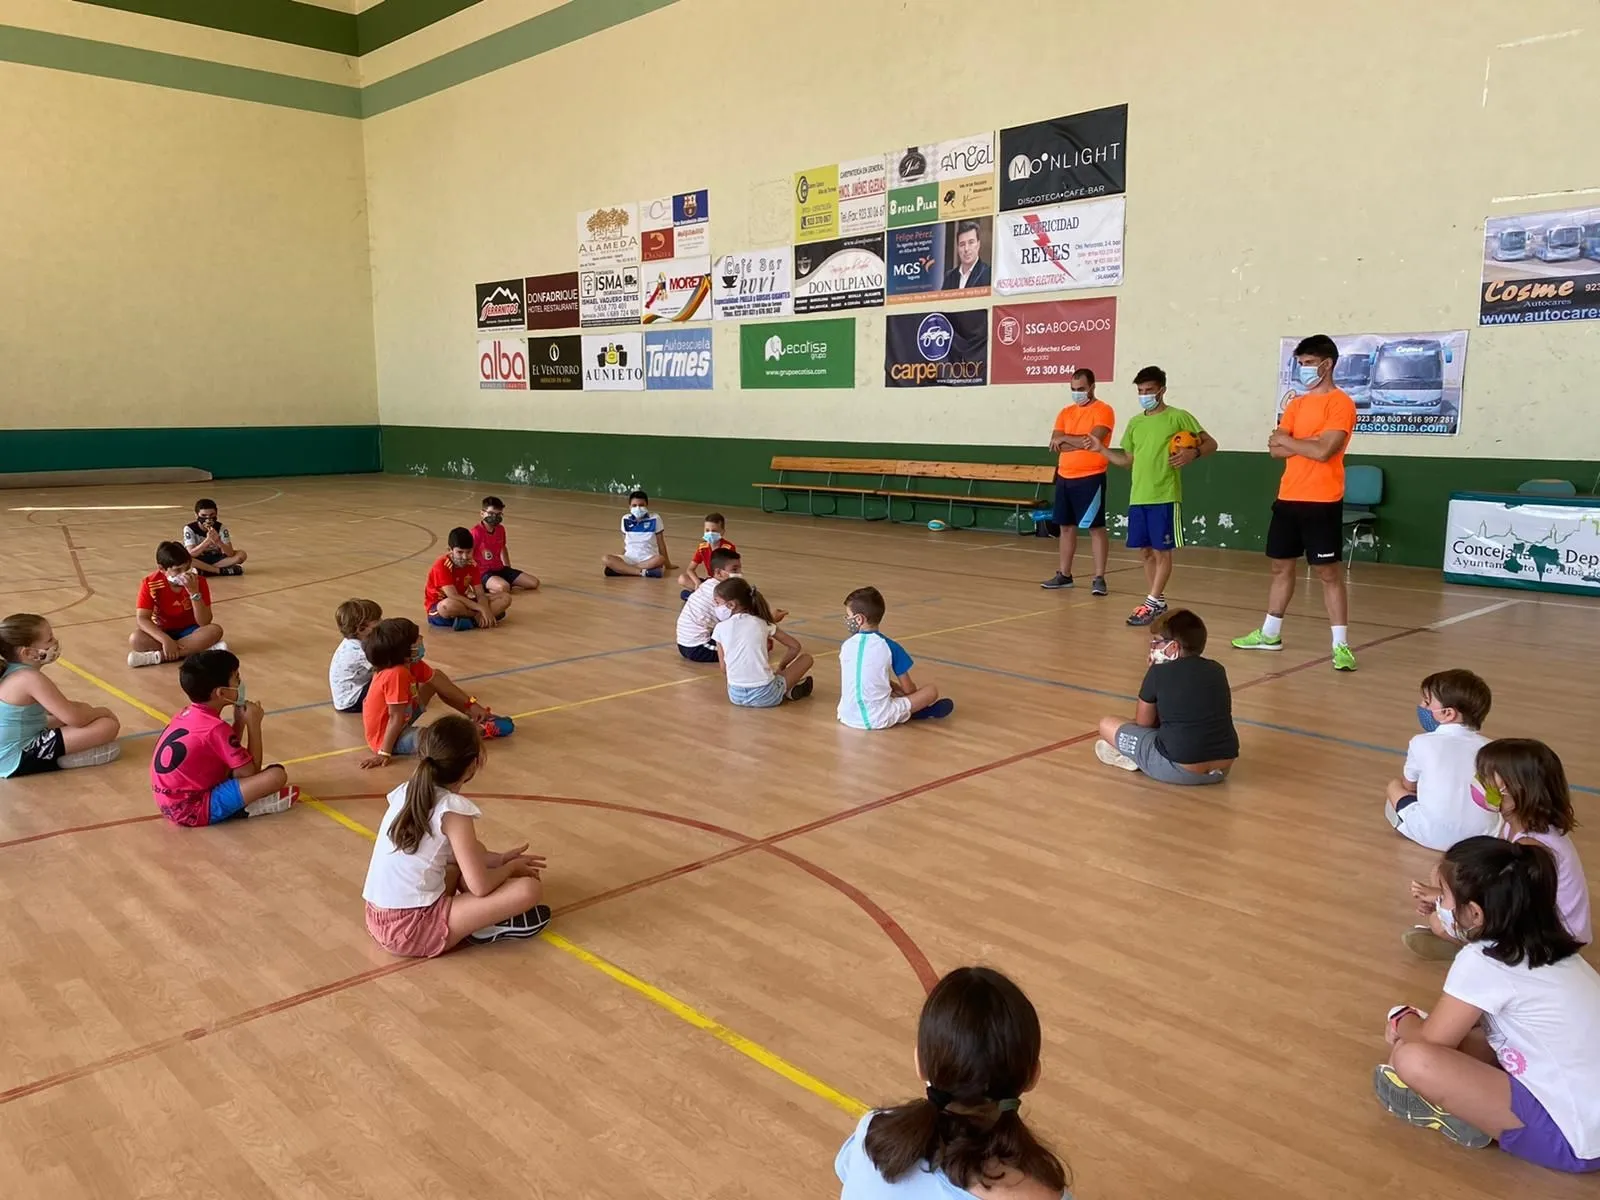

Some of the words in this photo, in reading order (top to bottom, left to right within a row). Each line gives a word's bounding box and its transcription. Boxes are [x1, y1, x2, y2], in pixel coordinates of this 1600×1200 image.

[916, 196, 937, 212] PILAR
[1013, 216, 1080, 237] ELECTRICIDAD
[578, 236, 638, 254] ALAMEDA
[1020, 243, 1070, 265] REYES
[893, 262, 921, 277] MGS
[595, 274, 623, 291] ISMA
[809, 280, 832, 295] DON
[834, 274, 883, 292] ULPIANO
[527, 289, 578, 304] DONFADRIQUE
[1484, 280, 1575, 302] Cosme
[527, 305, 543, 313] HOTEL
[1523, 299, 1572, 308] Autocares
[1481, 307, 1600, 324] www.autocare
[1025, 318, 1111, 335] SSGABOGADOS
[663, 338, 711, 350] Autoescuela
[786, 340, 827, 354] ecotisa
[480, 340, 526, 381] alba
[646, 344, 711, 378] Tormes
[810, 353, 827, 361] grupo
[541, 364, 580, 376] VENTORRO
[585, 367, 643, 381] AUNIETO
[765, 368, 827, 377] www.grupoecotisa.com
[890, 360, 983, 384] carpemotor
[1025, 366, 1041, 375] 923
[1042, 365, 1058, 375] 300
[1059, 364, 1076, 374] 844
[1356, 415, 1370, 423] 923
[1372, 415, 1386, 423] 120
[1408, 415, 1423, 423] 616
[1439, 416, 1454, 424] 281
[1353, 422, 1449, 433] rescosme.com
[154, 727, 190, 775] 6
